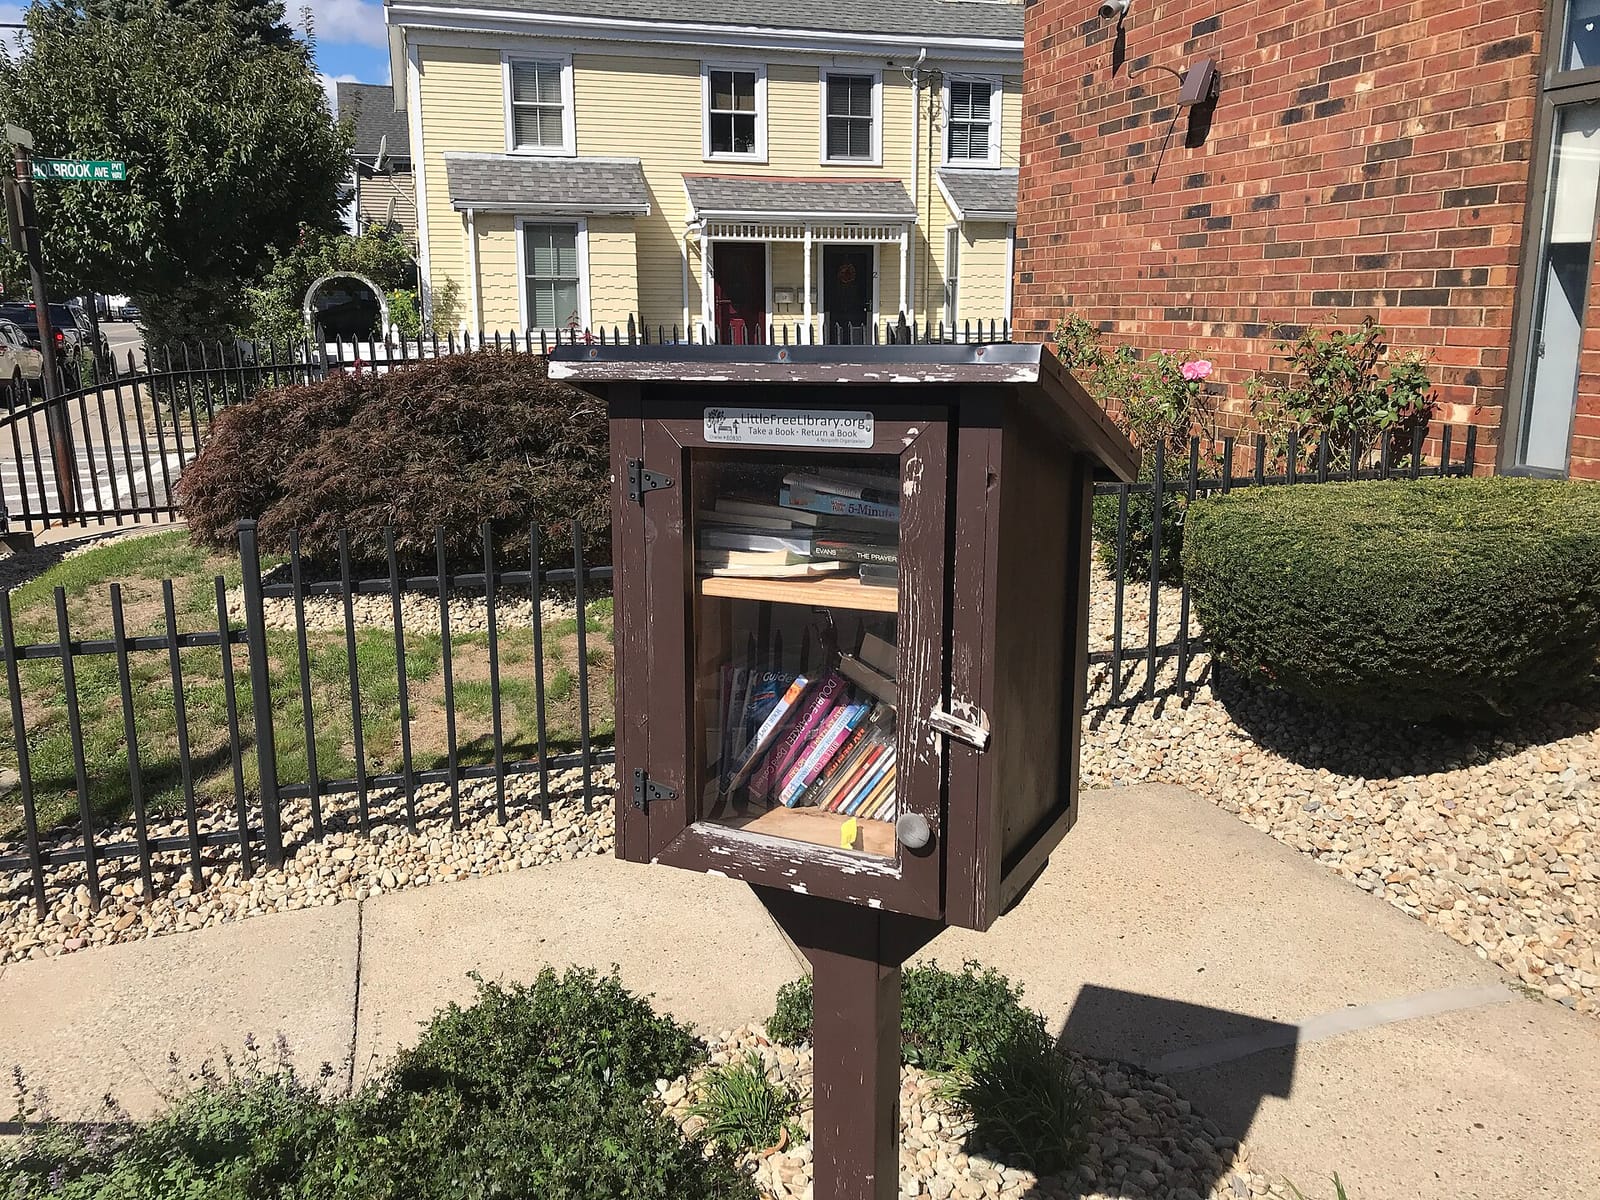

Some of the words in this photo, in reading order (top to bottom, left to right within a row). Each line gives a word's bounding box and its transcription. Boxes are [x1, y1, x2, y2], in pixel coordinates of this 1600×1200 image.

[32, 163, 92, 178] HOLBROOK
[94, 167, 109, 178] AVE
[111, 163, 122, 171] PVT
[741, 412, 865, 430] LittleFreeLibrary.org
[748, 427, 767, 436] Take
[775, 427, 795, 436] Book
[801, 428, 828, 438] Return
[837, 429, 857, 438] Book
[848, 502, 897, 519] 5-Minute
[815, 547, 837, 556] EVANS
[856, 552, 870, 560] THE
[871, 553, 898, 563] PRAYER
[809, 678, 837, 714] DOUBLE
[784, 711, 814, 748] CARKEET
